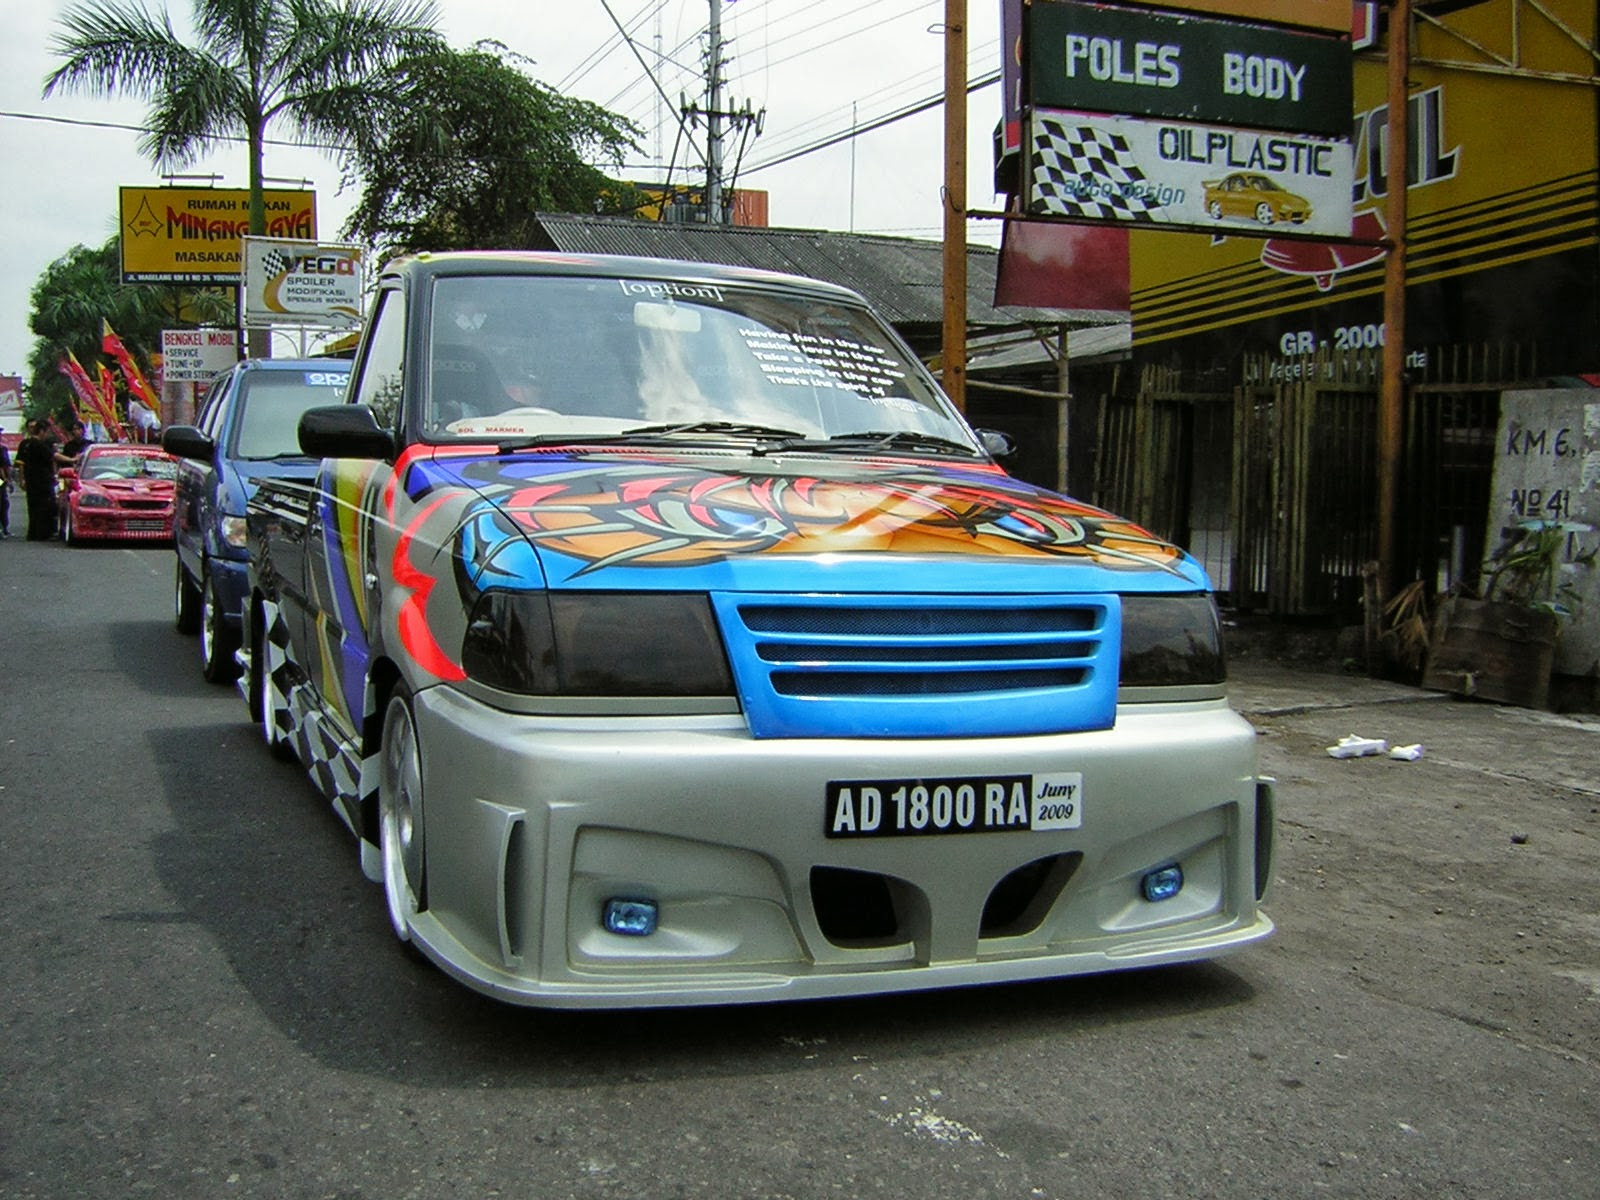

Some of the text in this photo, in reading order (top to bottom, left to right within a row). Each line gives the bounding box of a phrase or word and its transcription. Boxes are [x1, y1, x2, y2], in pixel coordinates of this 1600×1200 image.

[1065, 34, 1305, 102] POLES BODY
[1063, 176, 1185, 207] auto design
[187, 200, 290, 211] RUMAH MKAN
[287, 276, 335, 286] SPOILER
[287, 287, 345, 296] MODIFIKASI
[164, 332, 235, 346] BENGKEL MOBIL
[738, 328, 885, 354] Having fun in the car
[1280, 331, 1315, 356] GR
[169, 348, 199, 358] SERVICE
[746, 340, 899, 367] Making love in the car
[170, 370, 193, 379] POWER
[752, 351, 789, 362] Take
[806, 357, 838, 367] rest
[840, 360, 855, 370] in
[856, 363, 880, 373] the
[883, 369, 905, 378] car
[760, 363, 894, 386] Sleeping in the car
[810, 377, 833, 388] the
[836, 382, 870, 393] spirit
[871, 387, 885, 397] of
[1036, 782, 1076, 799] Juny
[833, 782, 1029, 832] AD 1800 RA
[1038, 803, 1074, 821] 2009
